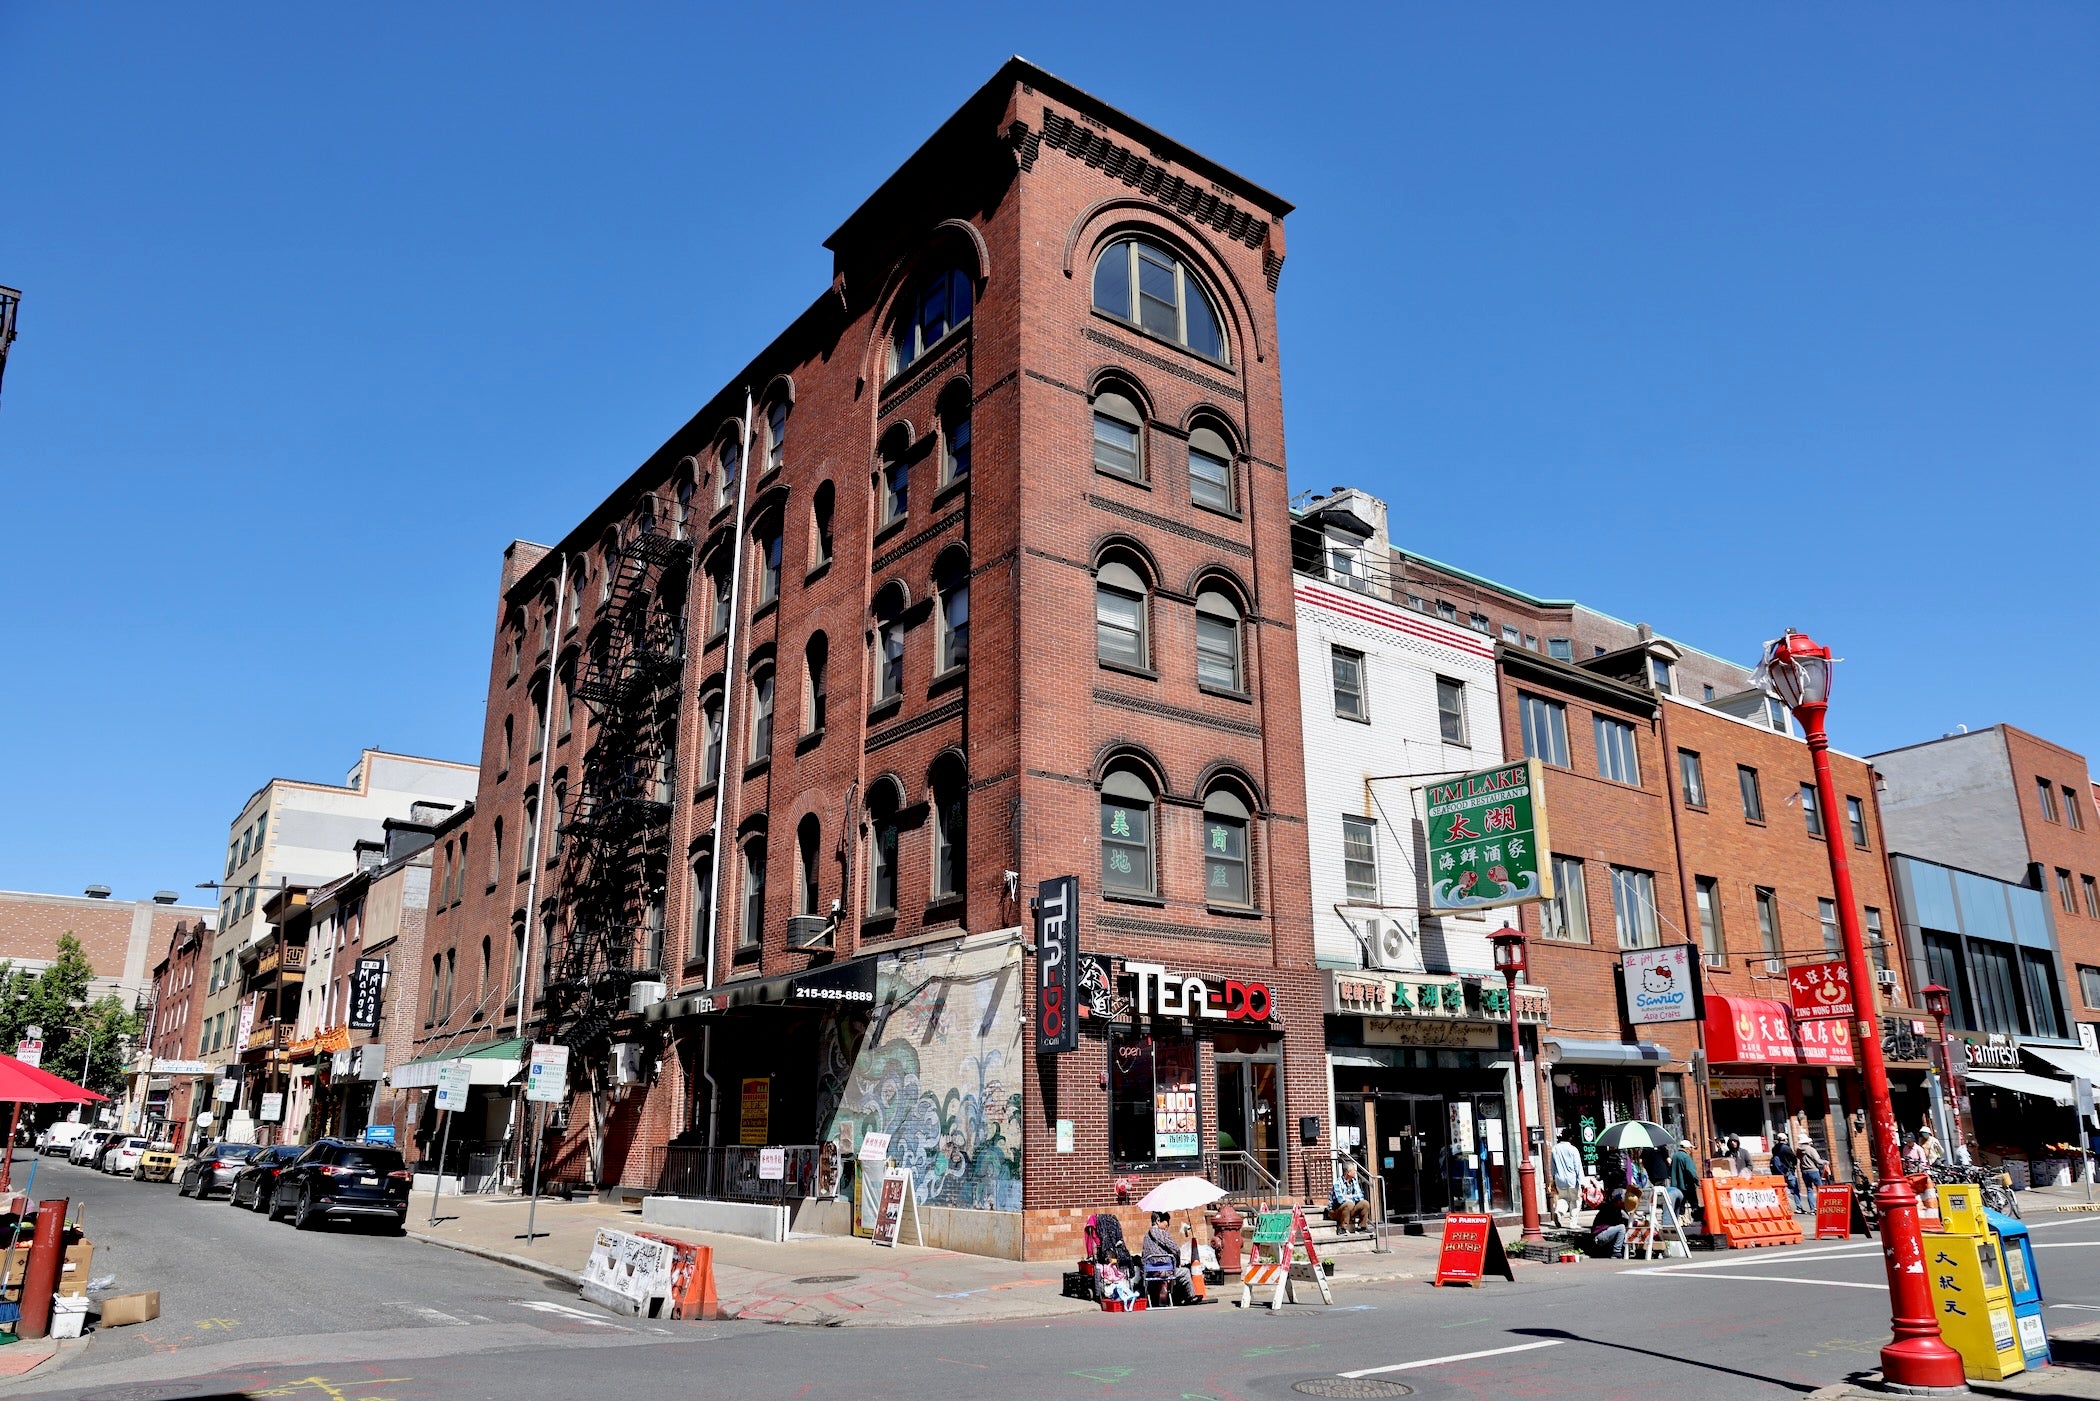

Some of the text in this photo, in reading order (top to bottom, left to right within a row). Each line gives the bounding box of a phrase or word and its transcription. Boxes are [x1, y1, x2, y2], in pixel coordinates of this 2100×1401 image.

[1430, 767, 1527, 806] TAI LAKE
[1432, 787, 1525, 816] SEAFOOD RESTAURANT
[1110, 809, 1229, 852] 美 商
[1444, 803, 1517, 843] 太湖
[1110, 848, 1131, 873] 地
[1438, 837, 1527, 871] 海鮮酒家
[1043, 882, 1068, 1038] TEA-DO
[796, 987, 873, 1001] 215-925-8889
[1124, 961, 1272, 1021] TEA-DO
[1636, 991, 1684, 1007] Sanrio
[1659, 1011, 1681, 1020] Crafts
[1795, 1007, 1811, 1017] TING
[1811, 1005, 1830, 1015] WONG
[1735, 1191, 1776, 1205] NO PARKING
[1823, 1198, 1843, 1206] FIRE
[1819, 1206, 1847, 1215] HOUSE
[1452, 1232, 1478, 1241] FIRE
[1443, 1242, 1482, 1252] HOUSE
[1934, 1251, 1967, 1316] 大紀元
